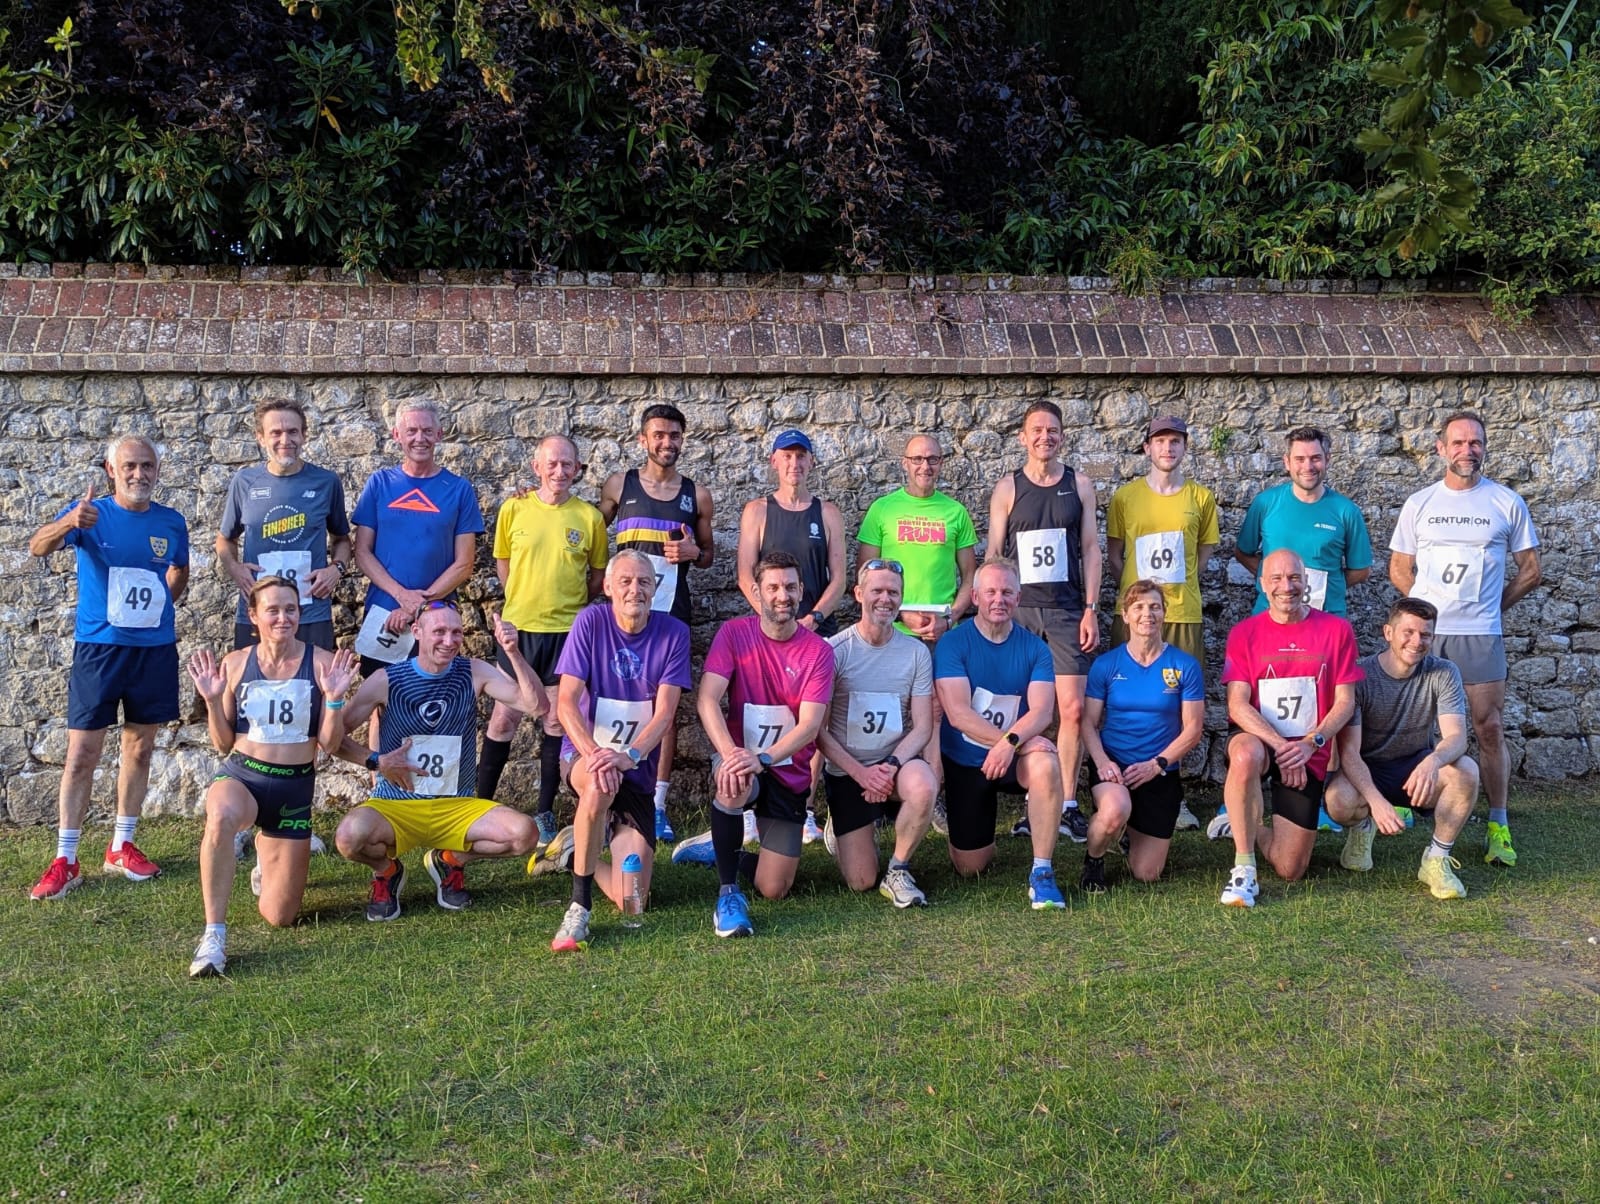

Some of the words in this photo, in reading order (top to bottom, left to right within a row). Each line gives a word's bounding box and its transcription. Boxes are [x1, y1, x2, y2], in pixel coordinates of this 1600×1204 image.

[898, 525, 946, 544] RUN
[1032, 545, 1056, 568] 58
[1150, 548, 1173, 570] 69
[1441, 563, 1469, 585] 67
[125, 586, 153, 611] 49
[268, 699, 294, 725] 18
[1277, 696, 1303, 721] 57
[610, 720, 640, 745] 27
[862, 710, 888, 734] 37
[758, 724, 784, 748] 77
[244, 760, 269, 773] NIKE
[269, 767, 295, 776] PRO
[417, 753, 444, 778] 28
